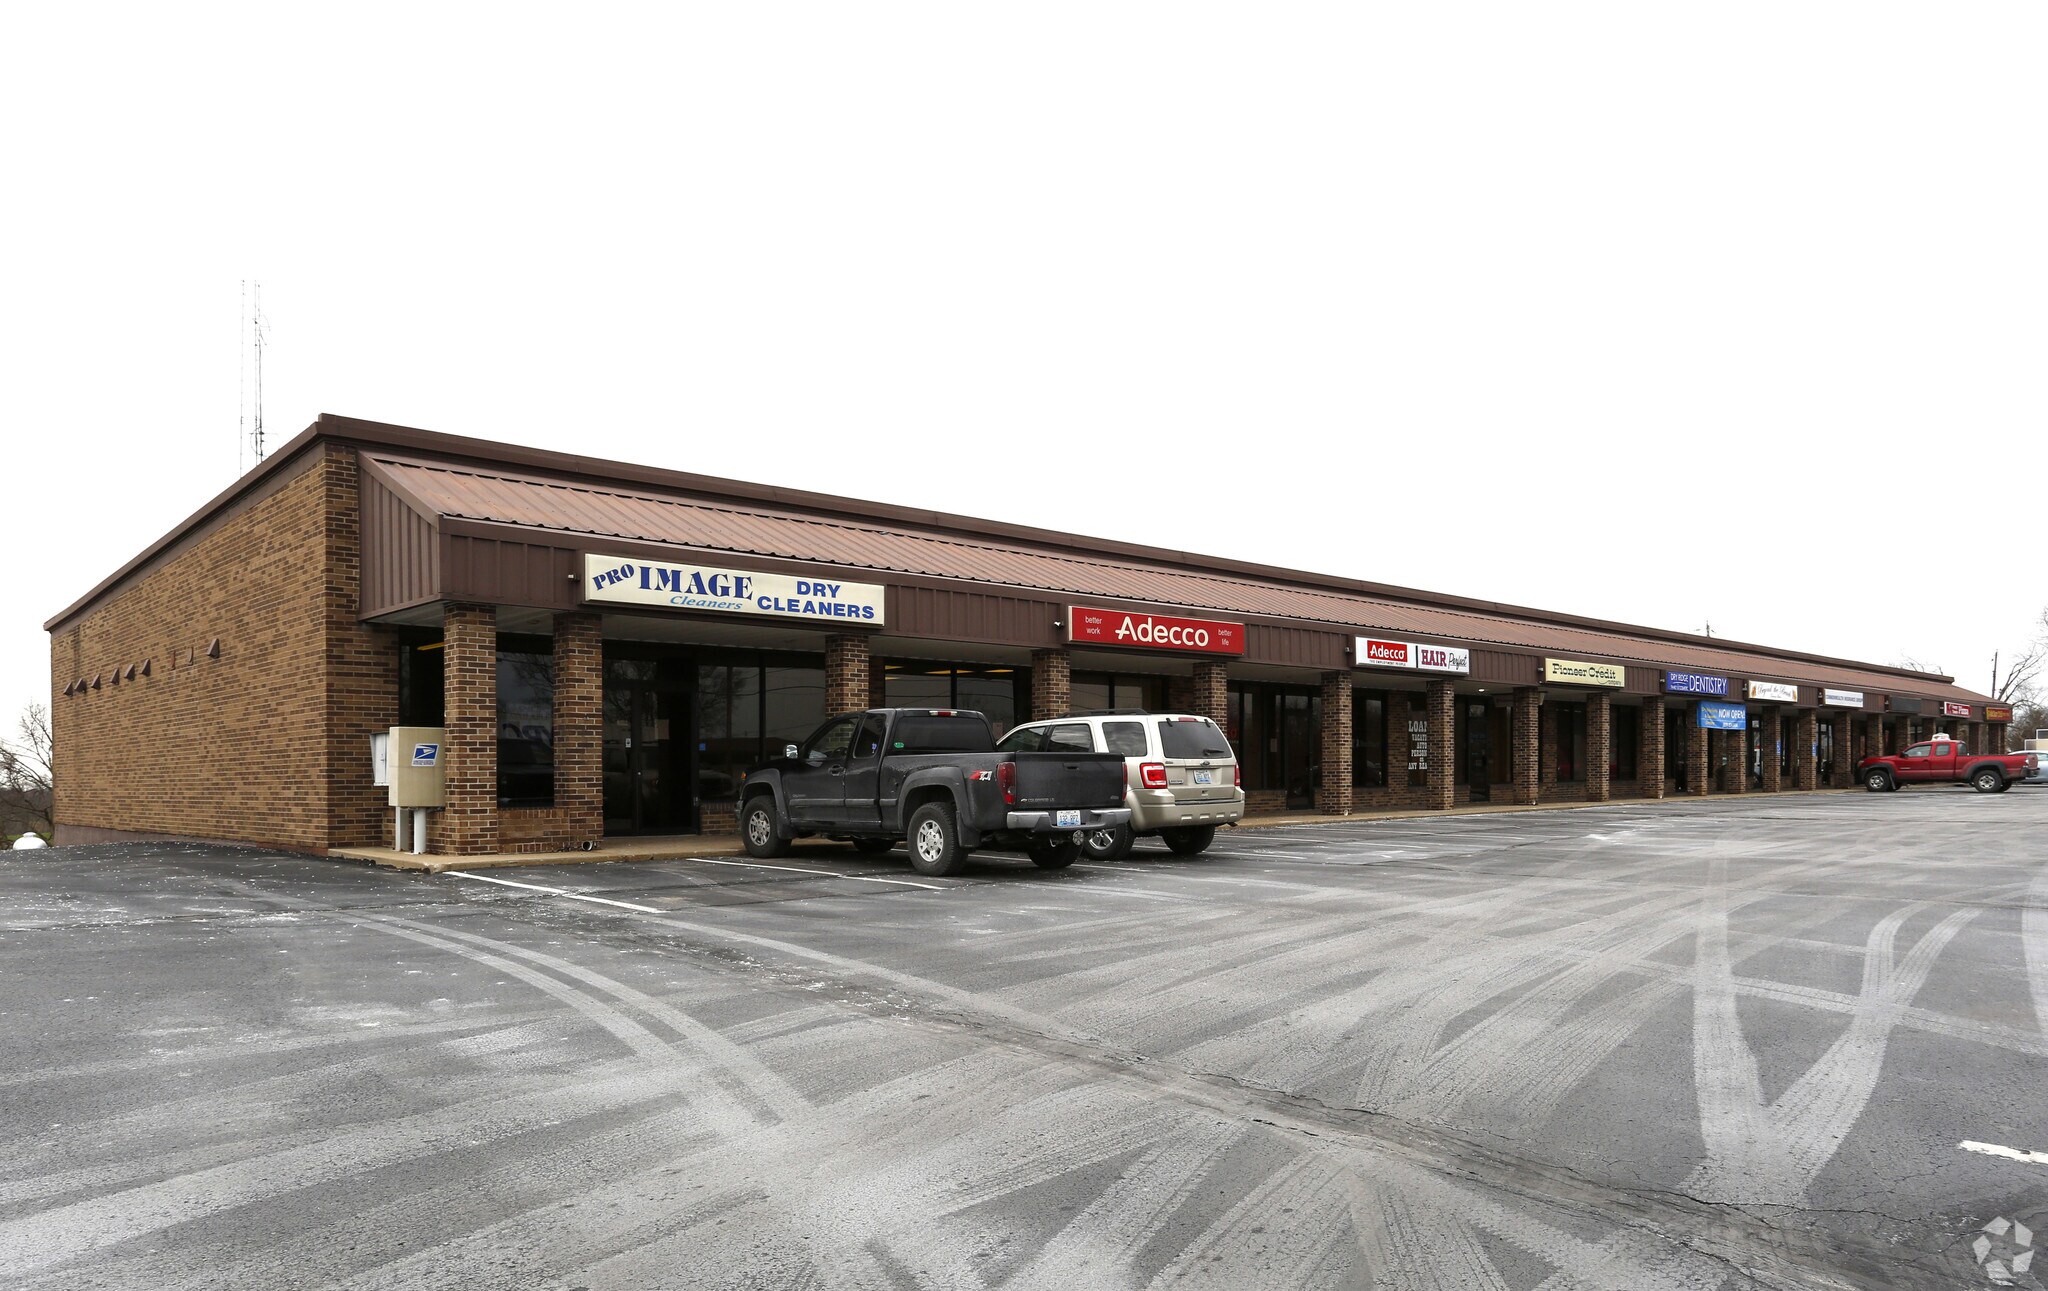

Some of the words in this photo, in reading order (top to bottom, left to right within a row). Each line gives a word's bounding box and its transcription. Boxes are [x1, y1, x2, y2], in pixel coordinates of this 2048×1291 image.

[592, 563, 635, 591] PRO
[638, 566, 754, 600] IMAGE
[796, 580, 841, 598] DRY
[669, 595, 743, 610] Cleaners
[757, 596, 875, 620] CLEANERS
[1085, 616, 1102, 625] better
[1086, 626, 1101, 635] work
[1115, 616, 1209, 647] Adecco
[1218, 628, 1232, 637] better
[1221, 638, 1230, 646] life
[1370, 644, 1405, 660] Adecco
[1421, 649, 1447, 667] HAIR
[1552, 662, 1587, 677] Pioneer
[1588, 666, 1616, 680] Credit
[1689, 675, 1727, 695] DENTISTRY
[1718, 709, 1731, 719] NOW
[1411, 733, 1428, 741] VACATI
[1411, 749, 1428, 757] PERSON
[1408, 762, 1418, 770] ANY
[1418, 762, 1428, 770] REA
